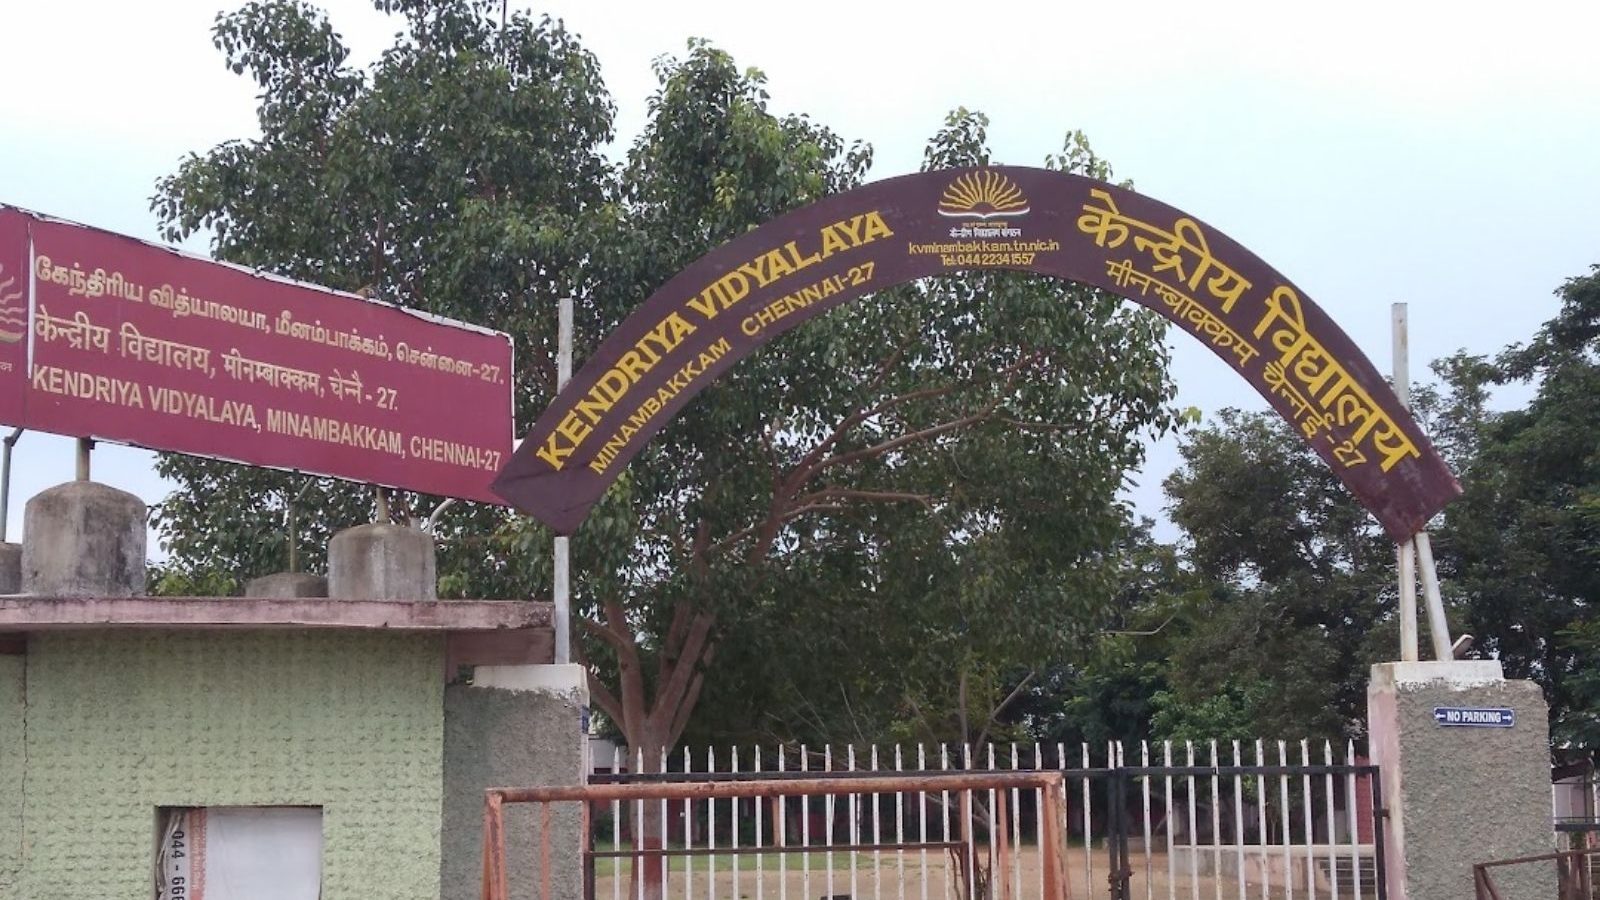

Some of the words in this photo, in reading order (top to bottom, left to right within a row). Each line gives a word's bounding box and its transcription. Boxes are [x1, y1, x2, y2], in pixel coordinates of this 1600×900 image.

[35, 255, 143, 302] கேந்திரிய
[149, 284, 271, 334] வித்யாலயா,
[275, 309, 392, 361] மீனம்பாக்கம்,
[35, 304, 110, 354] केन्द्रीय
[120, 321, 216, 379] विद्यालय,
[535, 311, 697, 472] KENDRIYA
[686, 210, 894, 321] VIDYALAYA
[1077, 188, 1253, 314] केन्द्रीय
[1253, 285, 1421, 473] विद्यालय
[32, 363, 144, 409] KENDRIYA
[148, 385, 262, 434] VIDYALAYA,
[267, 408, 406, 460] MINAMBAKKAM,
[410, 436, 501, 472] CHENNAI-27
[588, 336, 733, 476] MINAMBAKKAM
[740, 261, 876, 337] CHENNAI-27
[1446, 711, 1460, 722] NO
[1461, 711, 1502, 723] PARKING
[171, 830, 185, 859] 044
